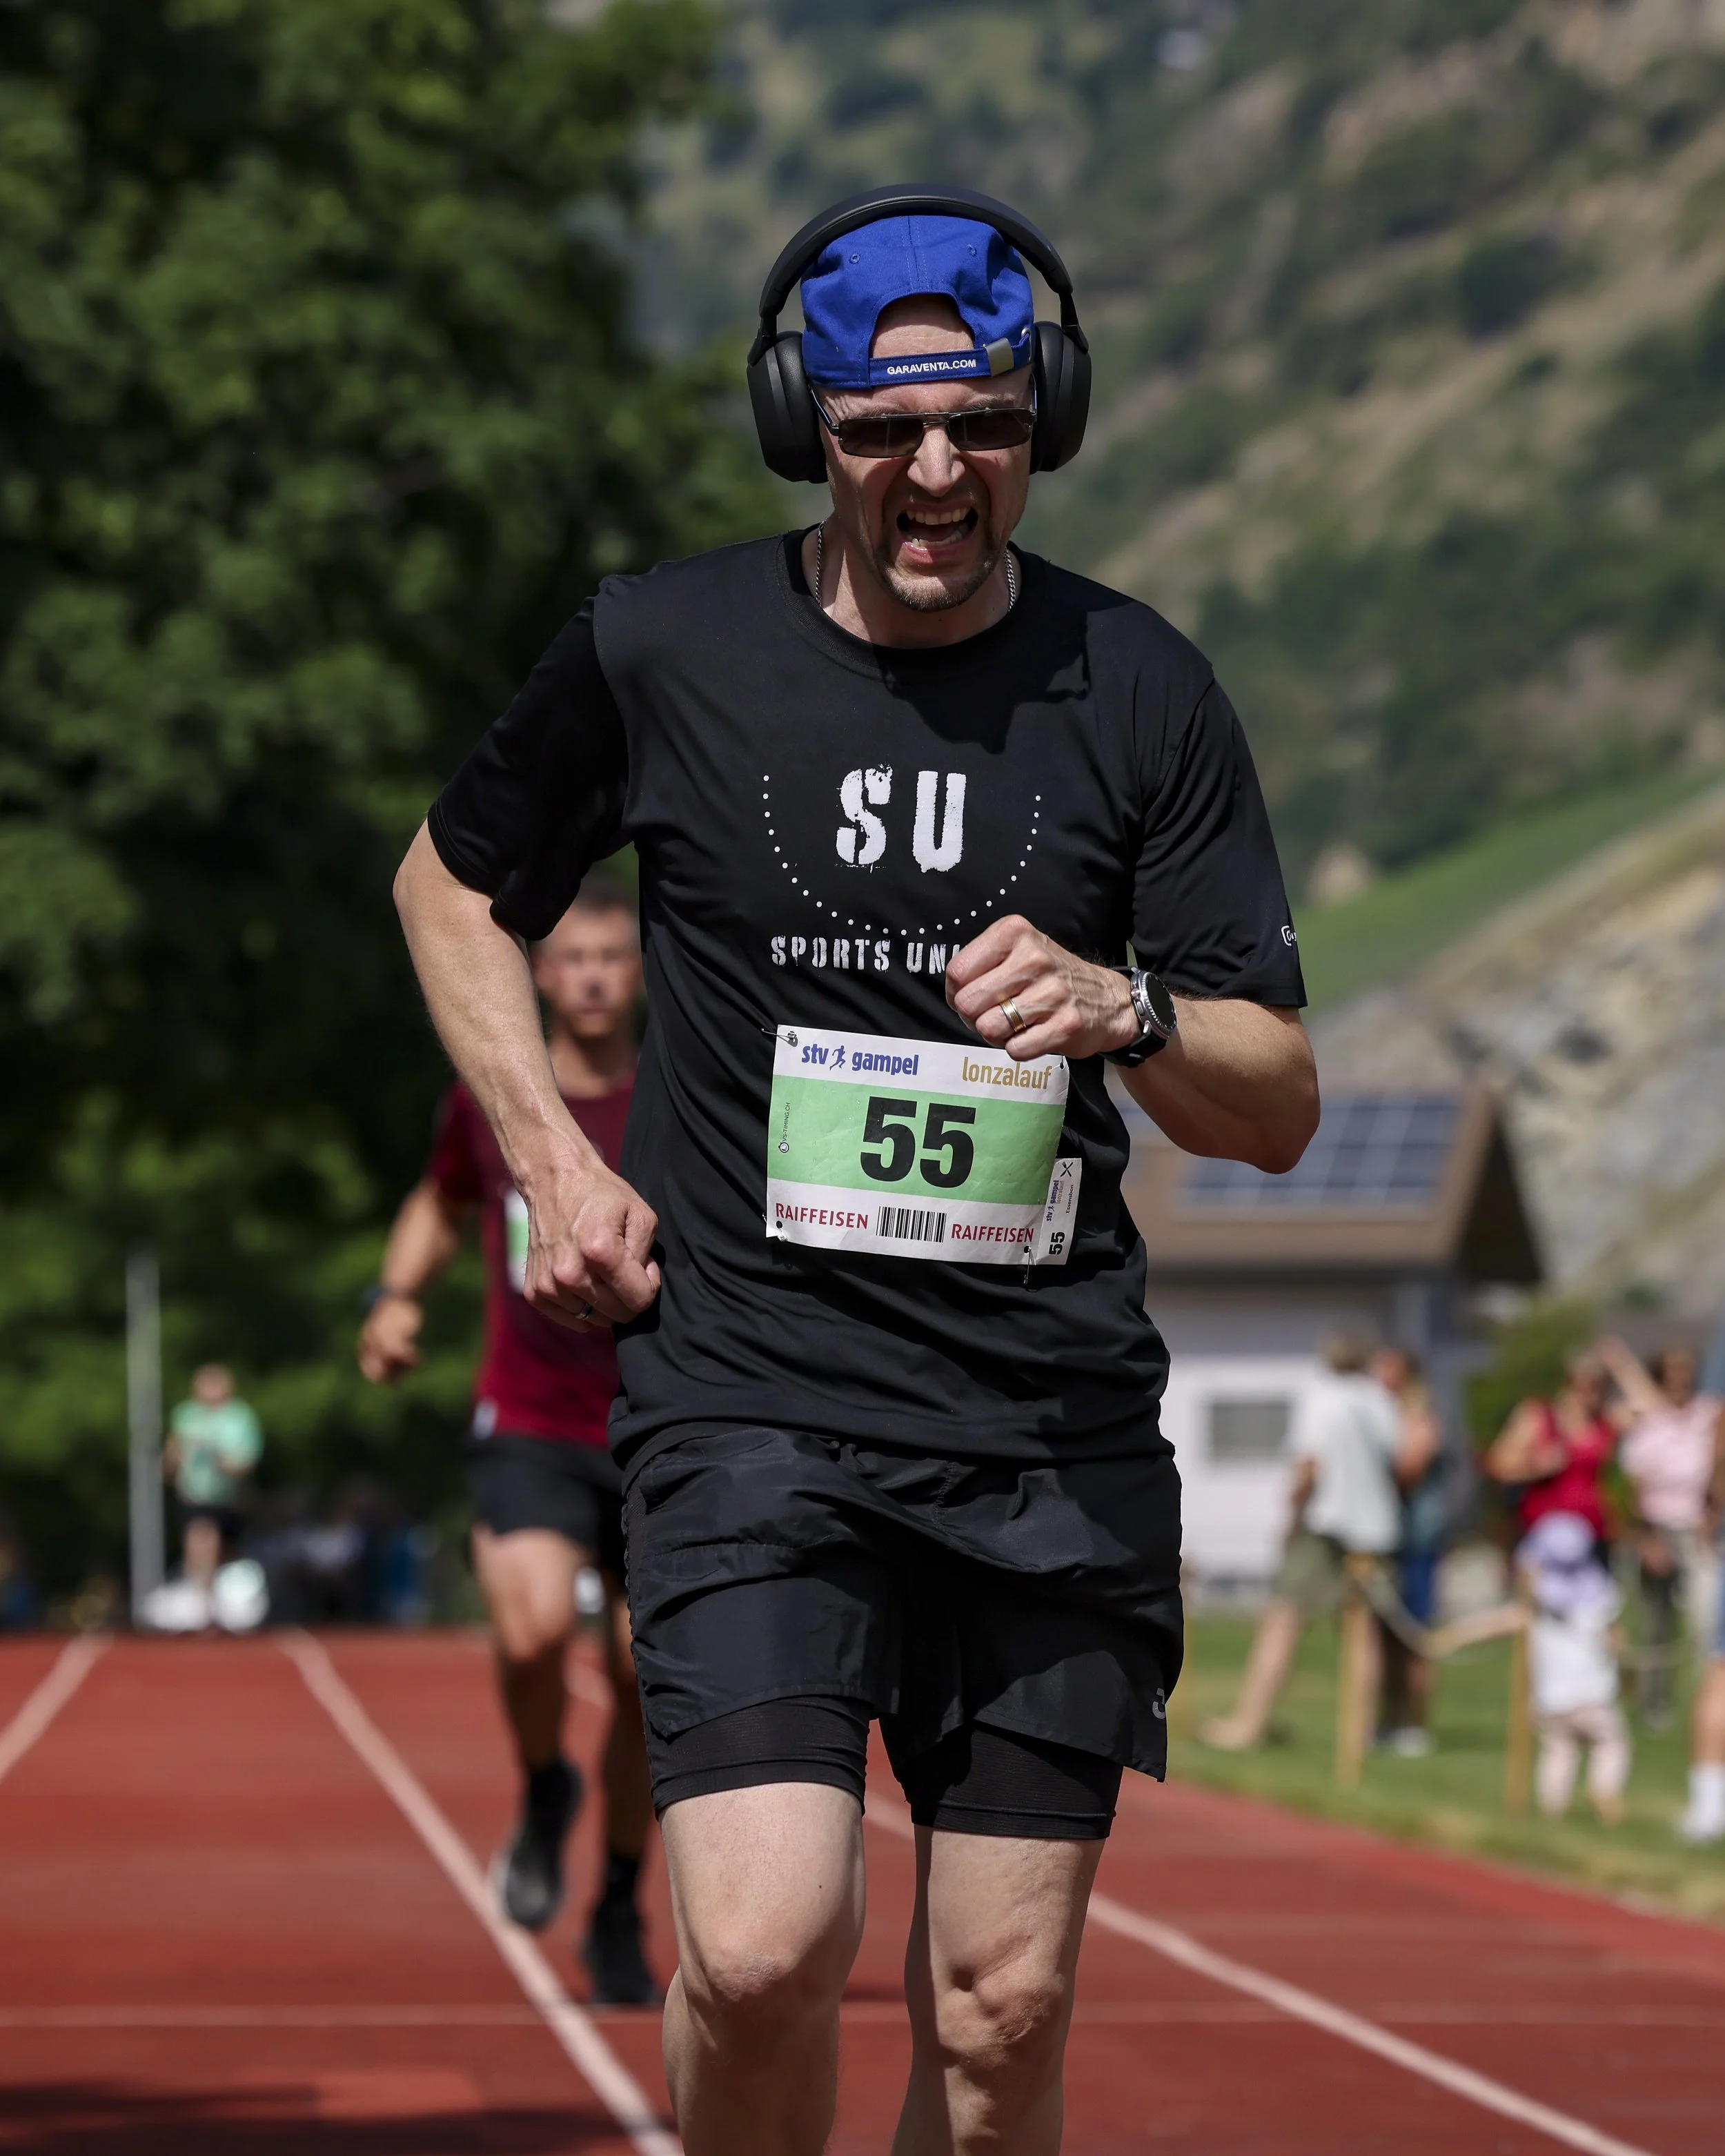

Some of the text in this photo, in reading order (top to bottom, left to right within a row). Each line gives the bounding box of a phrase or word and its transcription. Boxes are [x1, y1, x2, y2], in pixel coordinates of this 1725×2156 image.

[887, 359, 976, 375] GARAVENTA.COM
[771, 935, 891, 972] SPORTS
[801, 1043, 919, 1076] stv gampel
[962, 1056, 1052, 1089] lonzalauf
[782, 1102, 791, 1142] VS-TIMING.CH
[860, 1096, 977, 1188] 55
[1049, 1180, 1060, 1204] gampel
[1056, 1180, 1065, 1204] lonzalauf
[1065, 1184, 1074, 1214] Essensbon
[775, 1203, 869, 1229] RAIFFEISEN
[951, 1223, 1034, 1243] RAIFFEISEN
[1048, 1232, 1065, 1255] 55
